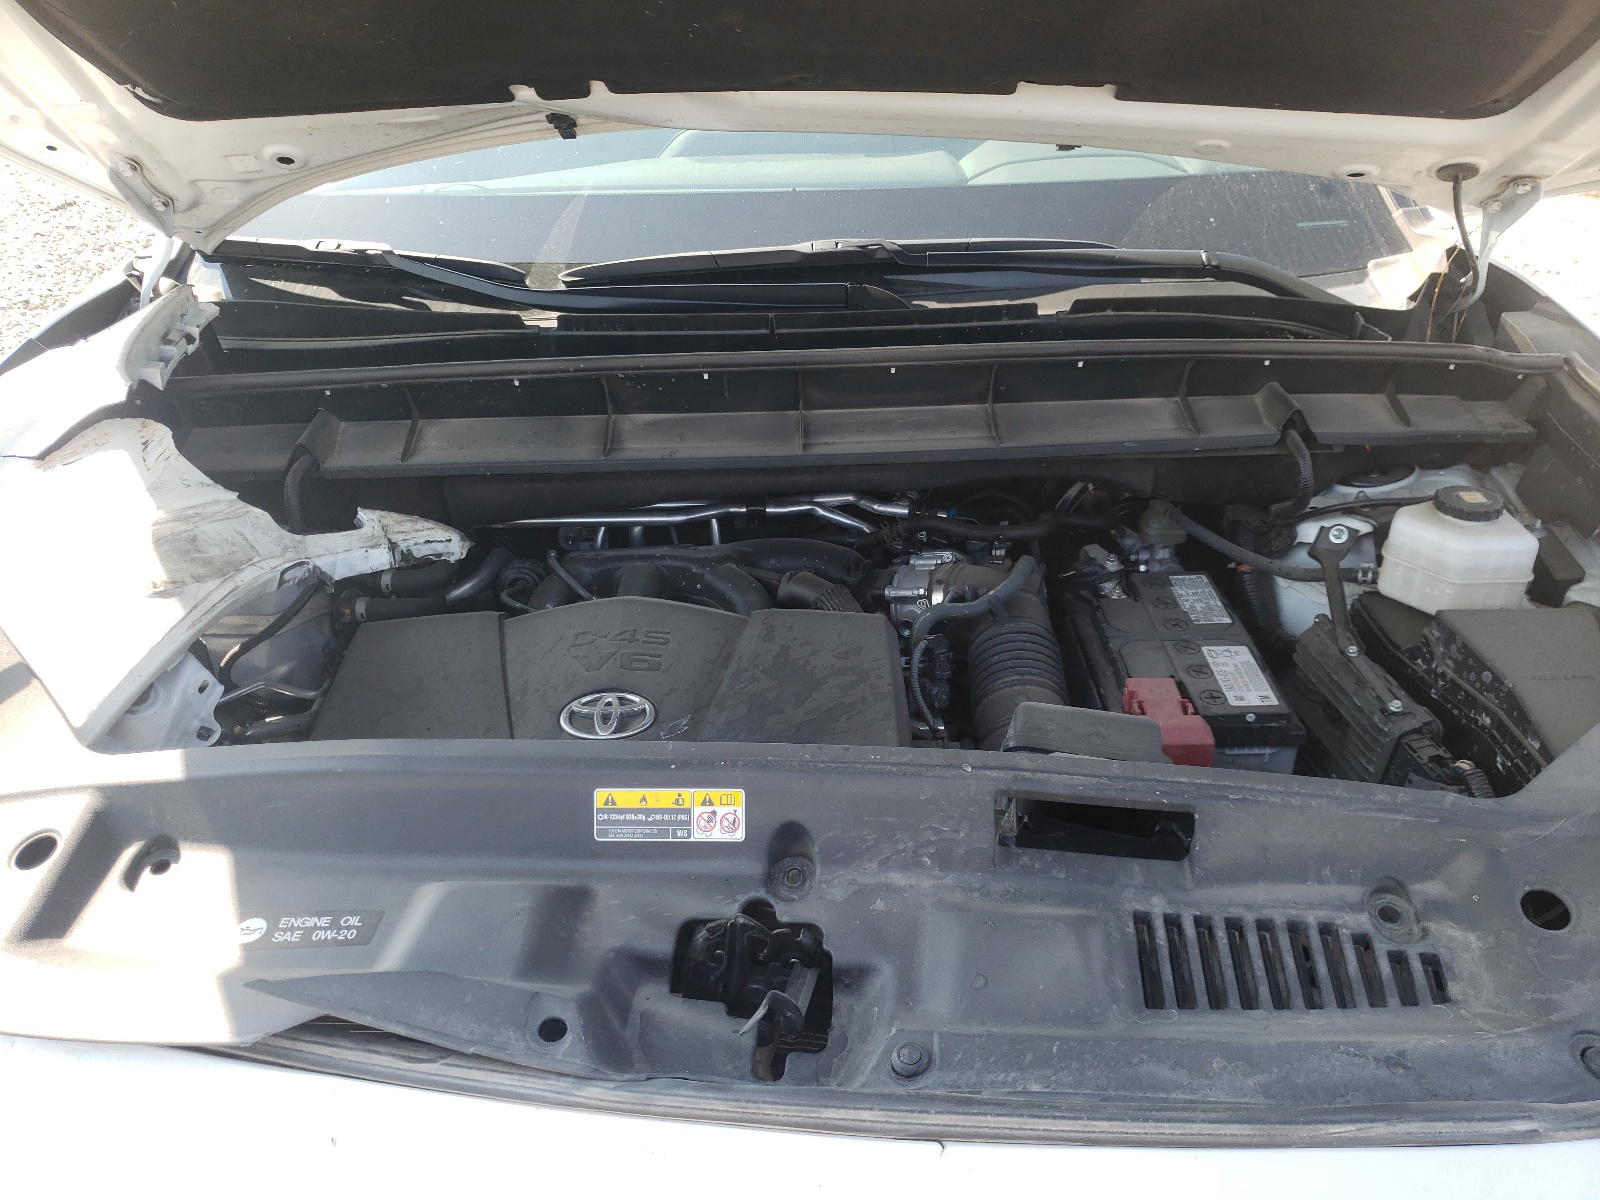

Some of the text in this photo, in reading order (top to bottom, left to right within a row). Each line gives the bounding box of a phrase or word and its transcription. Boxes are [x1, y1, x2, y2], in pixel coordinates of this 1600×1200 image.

[570, 628, 671, 647] D-4S
[571, 651, 662, 672] V6
[278, 915, 362, 928] ENGINE OIL
[271, 929, 357, 942] SAE 0W-20
